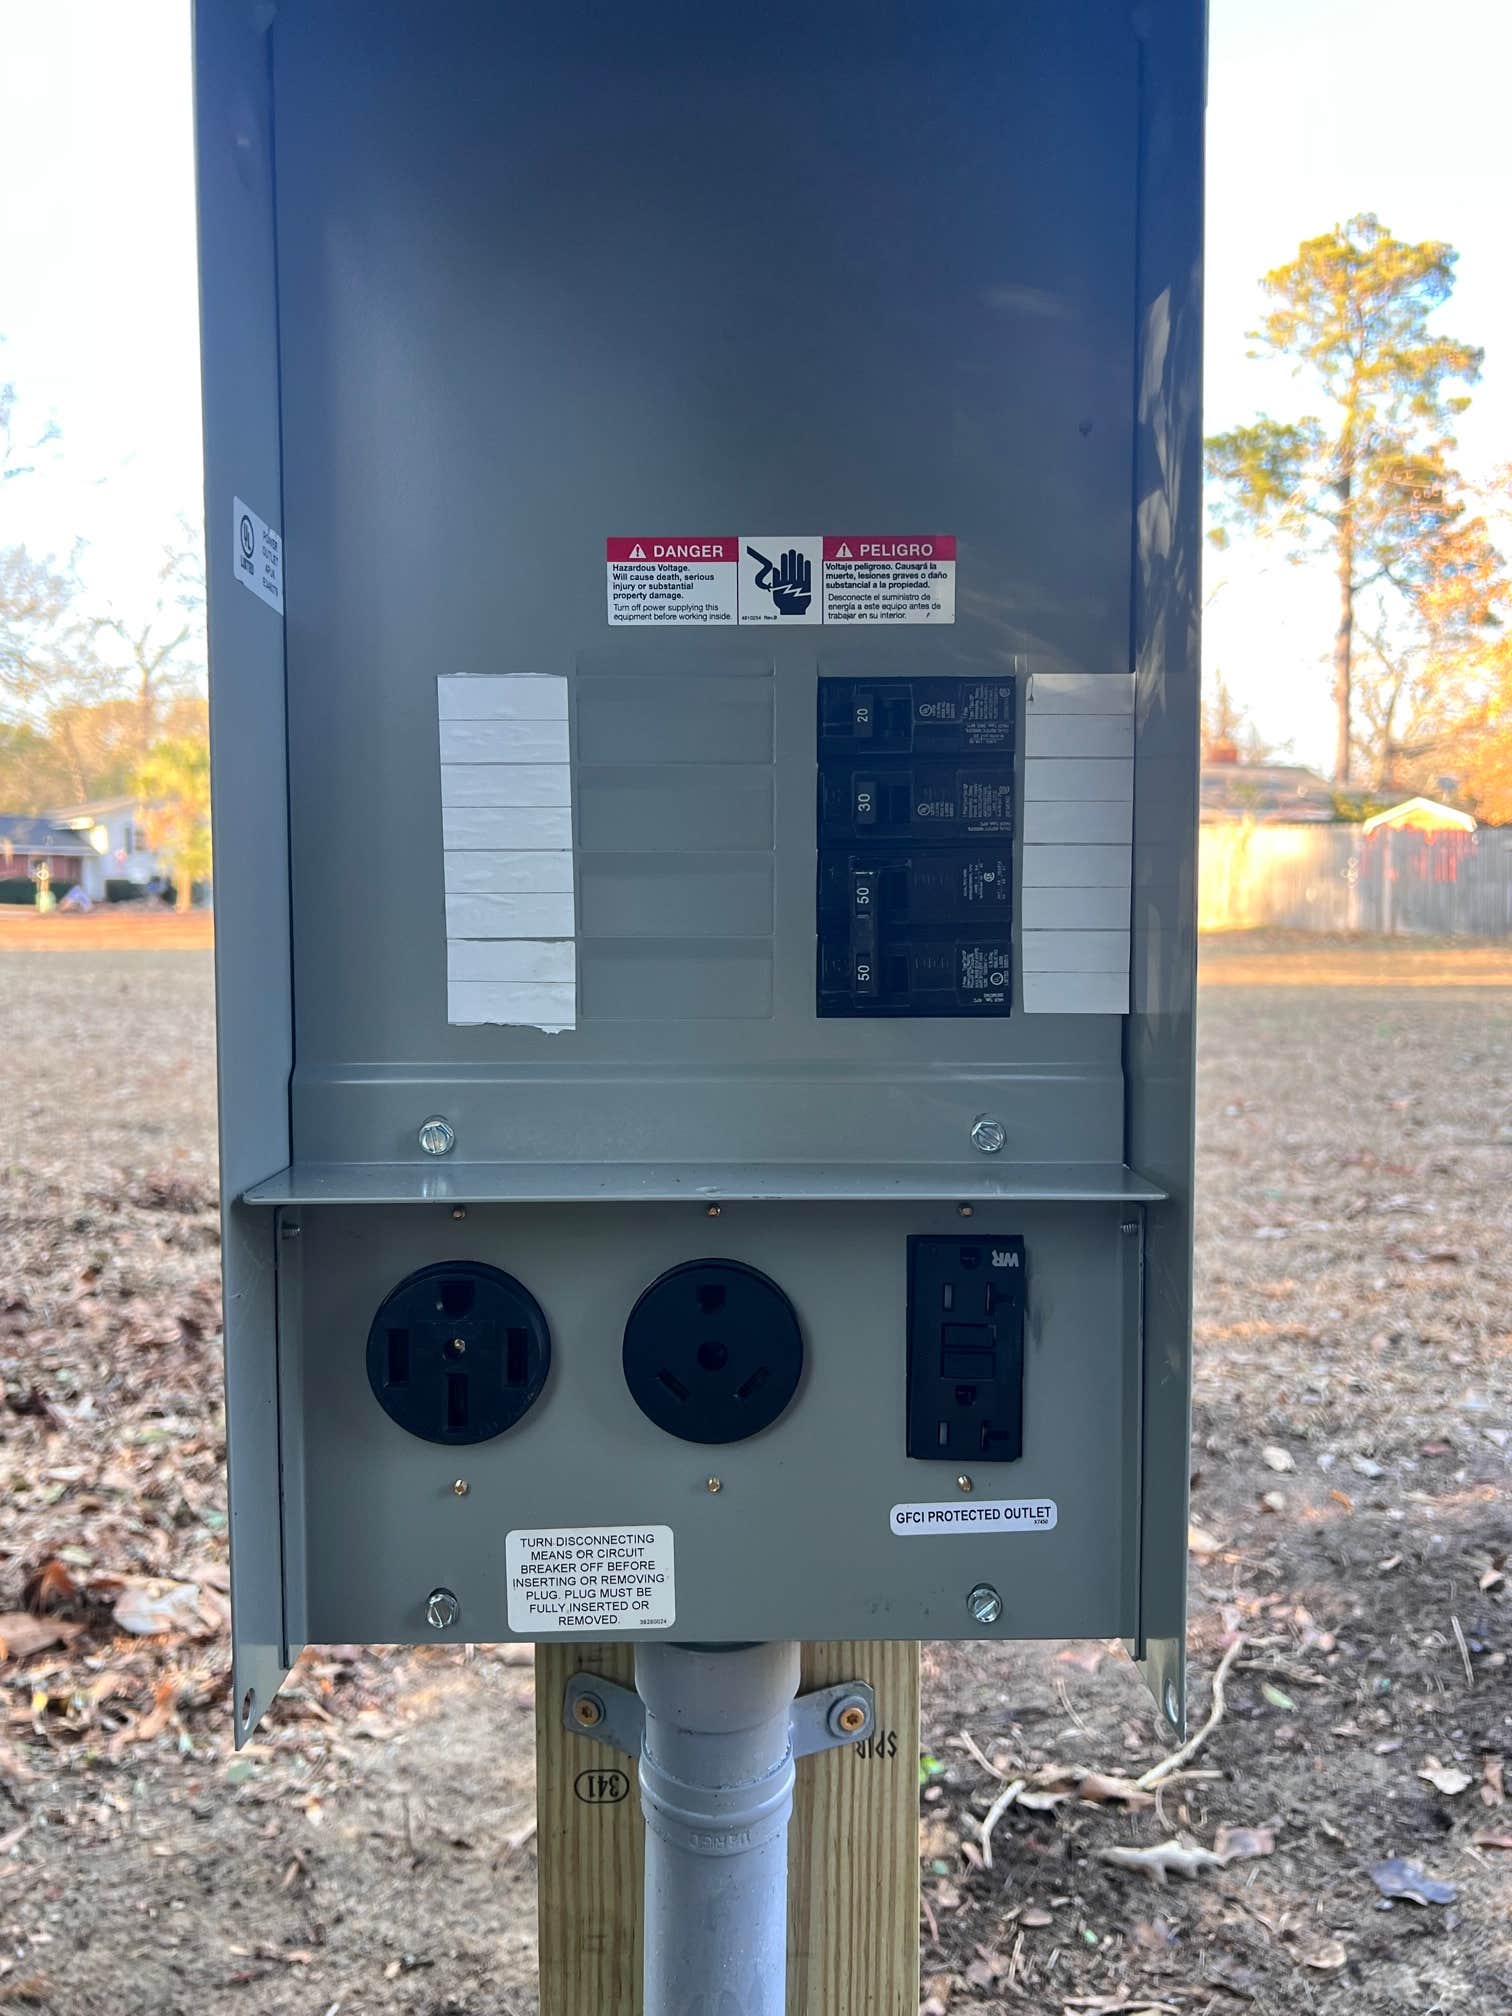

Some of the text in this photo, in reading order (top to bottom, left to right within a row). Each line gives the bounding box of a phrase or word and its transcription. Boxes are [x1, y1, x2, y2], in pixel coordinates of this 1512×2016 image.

[653, 545, 723, 558] DANGER
[860, 544, 933, 557] PELIGRO
[612, 564, 690, 574] Hazardous Voltage.
[826, 563, 852, 571] Voltaje
[854, 563, 893, 572] peligroso.
[895, 562, 928, 571] Causará
[613, 573, 628, 581] Will
[656, 573, 682, 582] death,
[684, 573, 714, 581] serious
[892, 573, 919, 581] graves
[613, 582, 635, 591] injury
[648, 582, 694, 590] substantial
[888, 581, 930, 590] propiedad.
[613, 591, 684, 600] property damage.
[873, 593, 880, 601] el
[668, 604, 703, 612] supplying
[828, 602, 855, 611] energía
[881, 603, 907, 611] equipo
[614, 613, 652, 621] equipment
[679, 613, 708, 621] working
[828, 612, 856, 621] trabajar
[856, 708, 868, 723] 20
[857, 793, 871, 812] 30
[856, 887, 869, 905] 50
[857, 965, 870, 982] 50
[991, 1249, 1020, 1267] WR
[896, 1506, 1051, 1524] GFCI PROTECTED OUTLET
[520, 1534, 655, 1548] TURN DISCONNECTING
[531, 1547, 645, 1561] MEANS OR CIRCUIT
[521, 1560, 656, 1574] BREAKER OFF BEFORE
[512, 1573, 665, 1588] INSERTING OR REMOVING
[526, 1587, 652, 1601] PLUG. PLUG MUST BE
[529, 1600, 649, 1614] FULLY INSERTED OR
[558, 1614, 620, 1626] REMOVED.
[585, 1775, 618, 1797] 341
